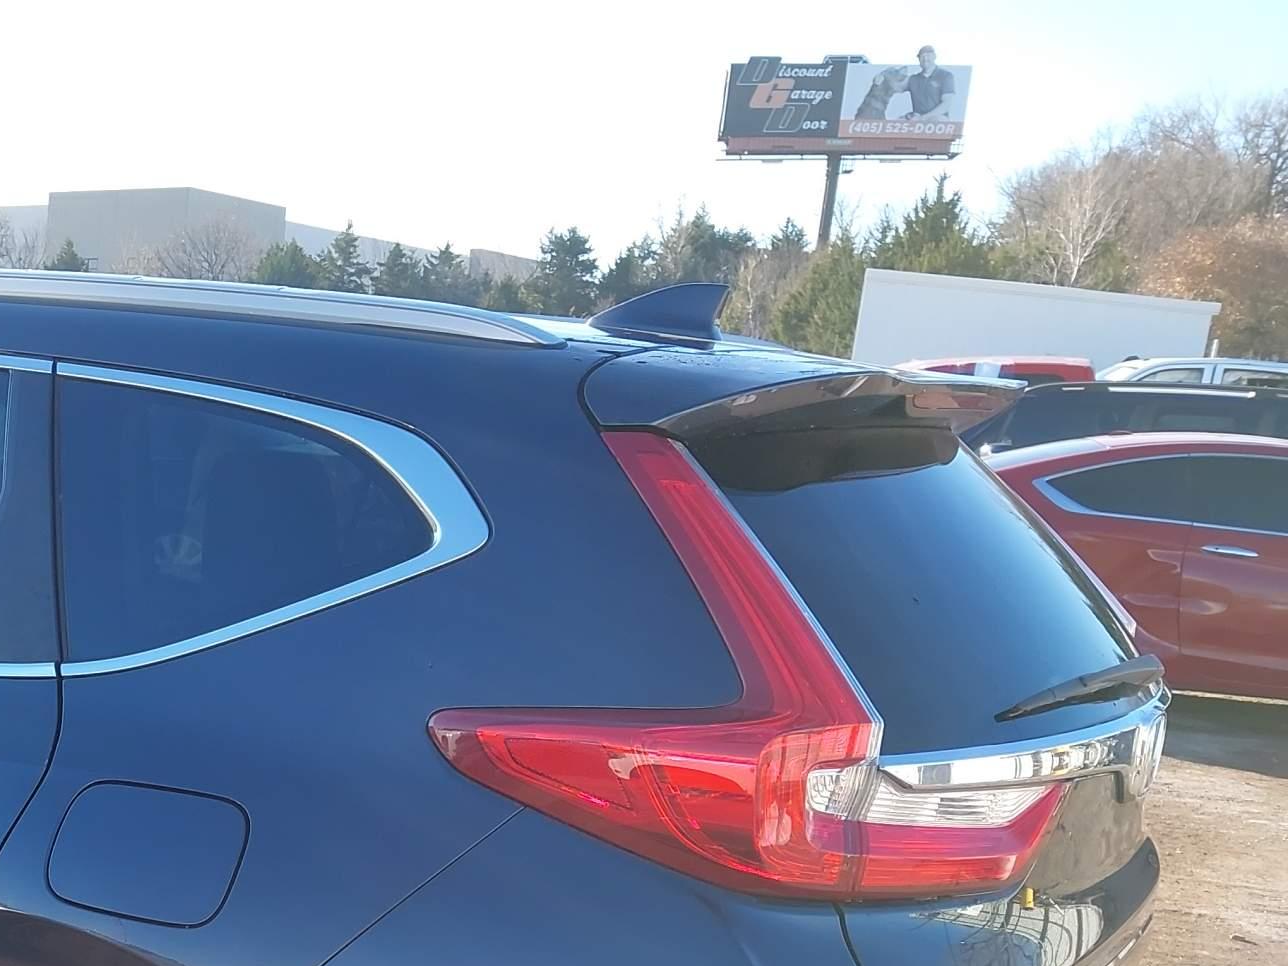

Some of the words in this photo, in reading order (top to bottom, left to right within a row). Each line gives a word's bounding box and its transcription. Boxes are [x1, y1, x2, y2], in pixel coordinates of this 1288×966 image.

[736, 56, 833, 86] Discount
[749, 78, 833, 109] Garage
[763, 102, 828, 133] Door
[848, 121, 884, 134] (405)
[885, 122, 956, 135] 525-DOOR
